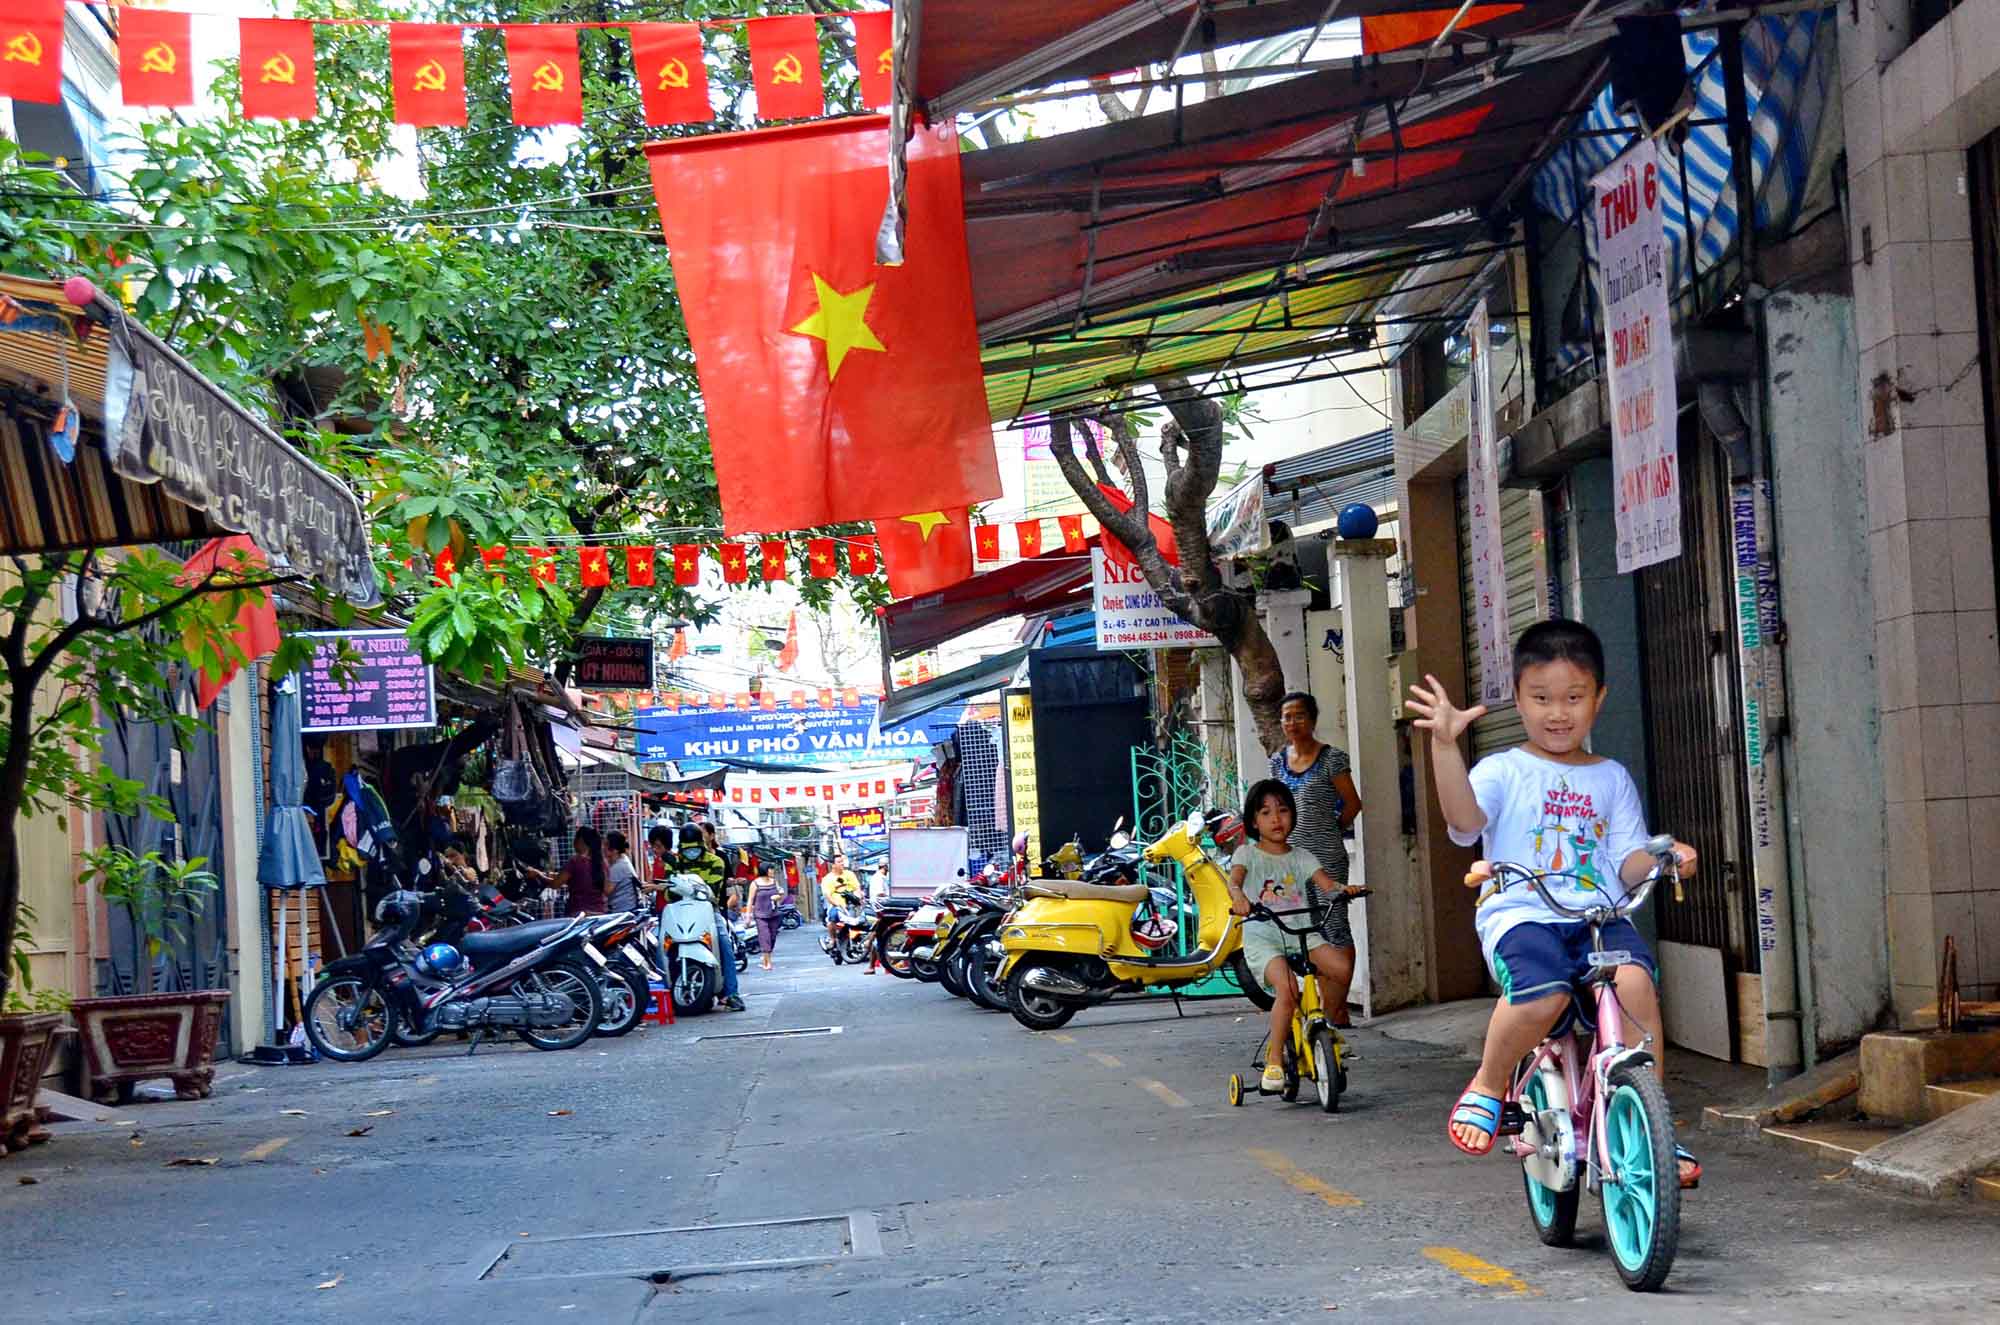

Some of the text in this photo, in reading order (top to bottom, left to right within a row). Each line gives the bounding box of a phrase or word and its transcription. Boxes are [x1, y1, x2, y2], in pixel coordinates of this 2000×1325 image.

[1644, 162, 1657, 211] 6
[1144, 617, 1160, 627] CAO
[684, 727, 929, 756] KHU PHỐ VĂN HÓA
[1548, 791, 1583, 803] ITCHY
